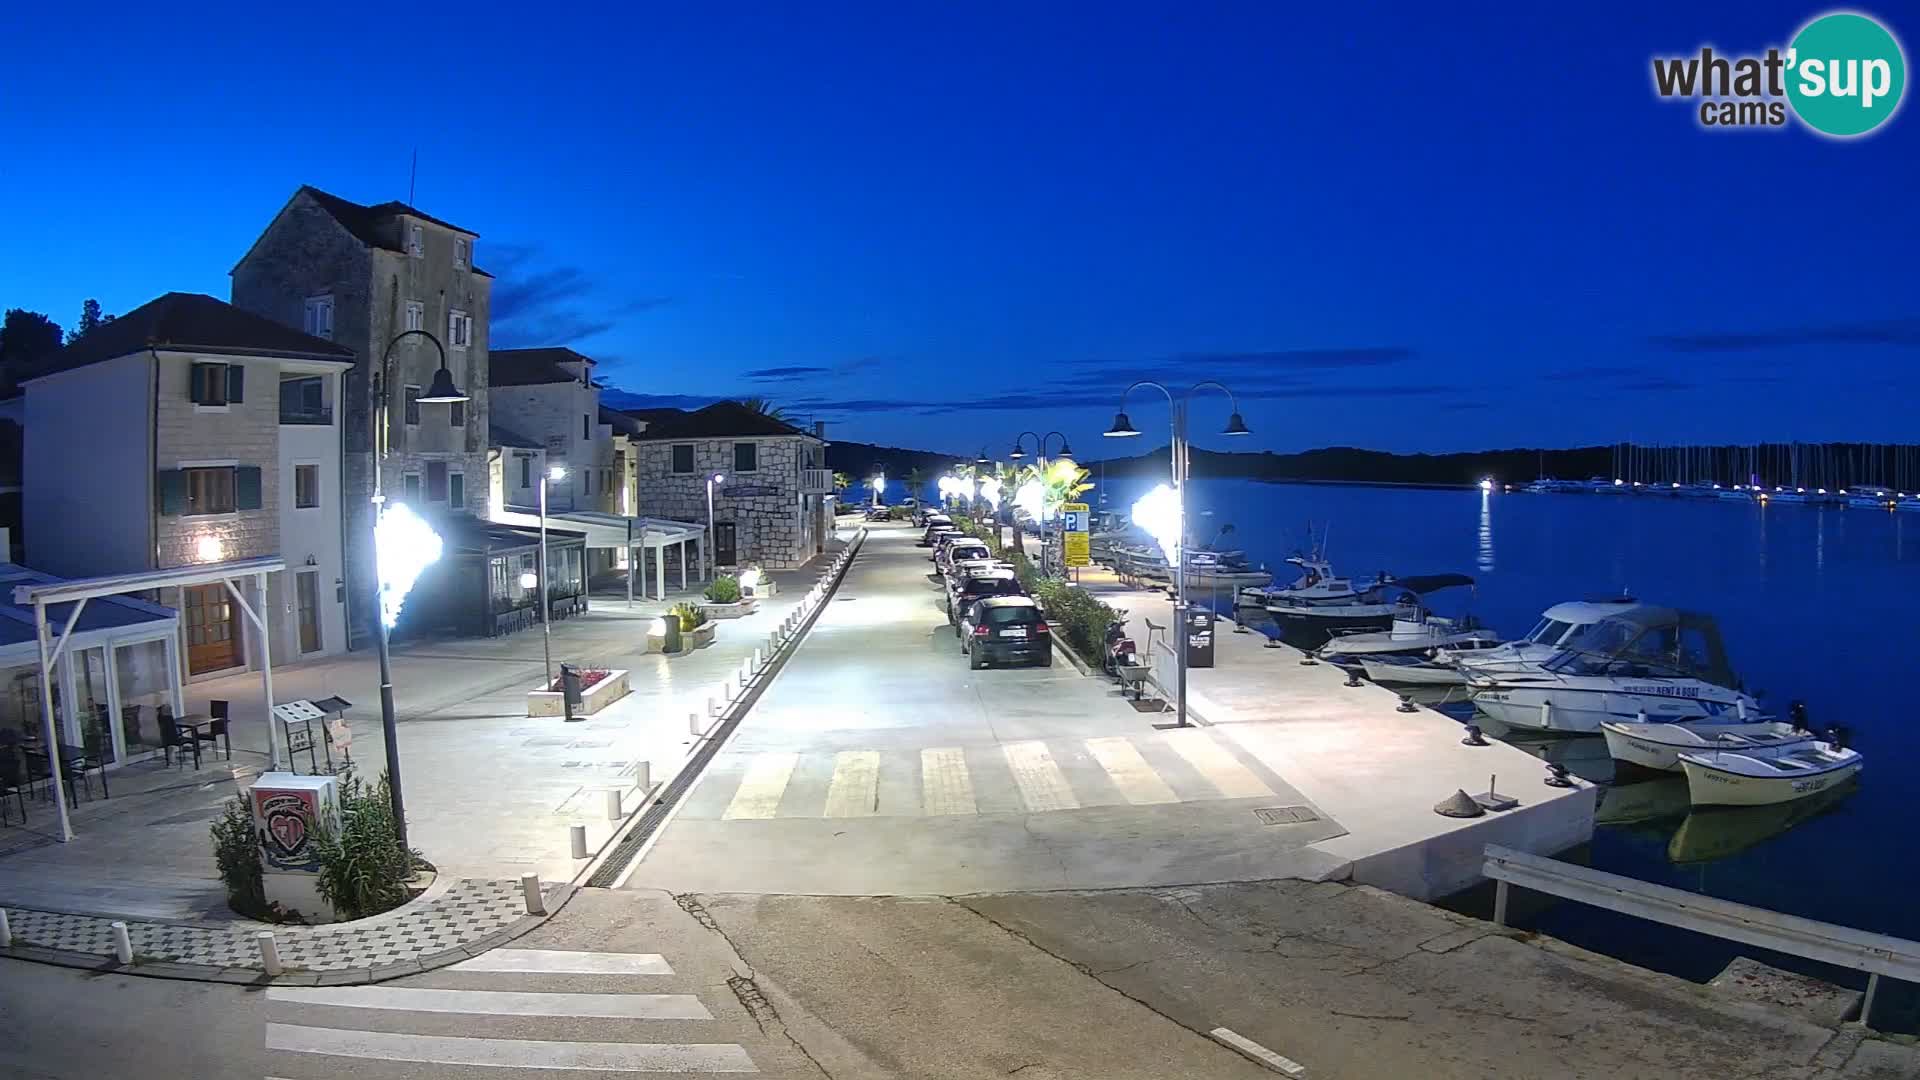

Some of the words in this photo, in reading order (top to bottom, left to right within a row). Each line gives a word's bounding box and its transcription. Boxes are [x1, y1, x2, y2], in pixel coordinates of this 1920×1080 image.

[1065, 514, 1077, 530] P
[1656, 686, 1674, 696] RENT
[1682, 687, 1699, 697] BOAT
